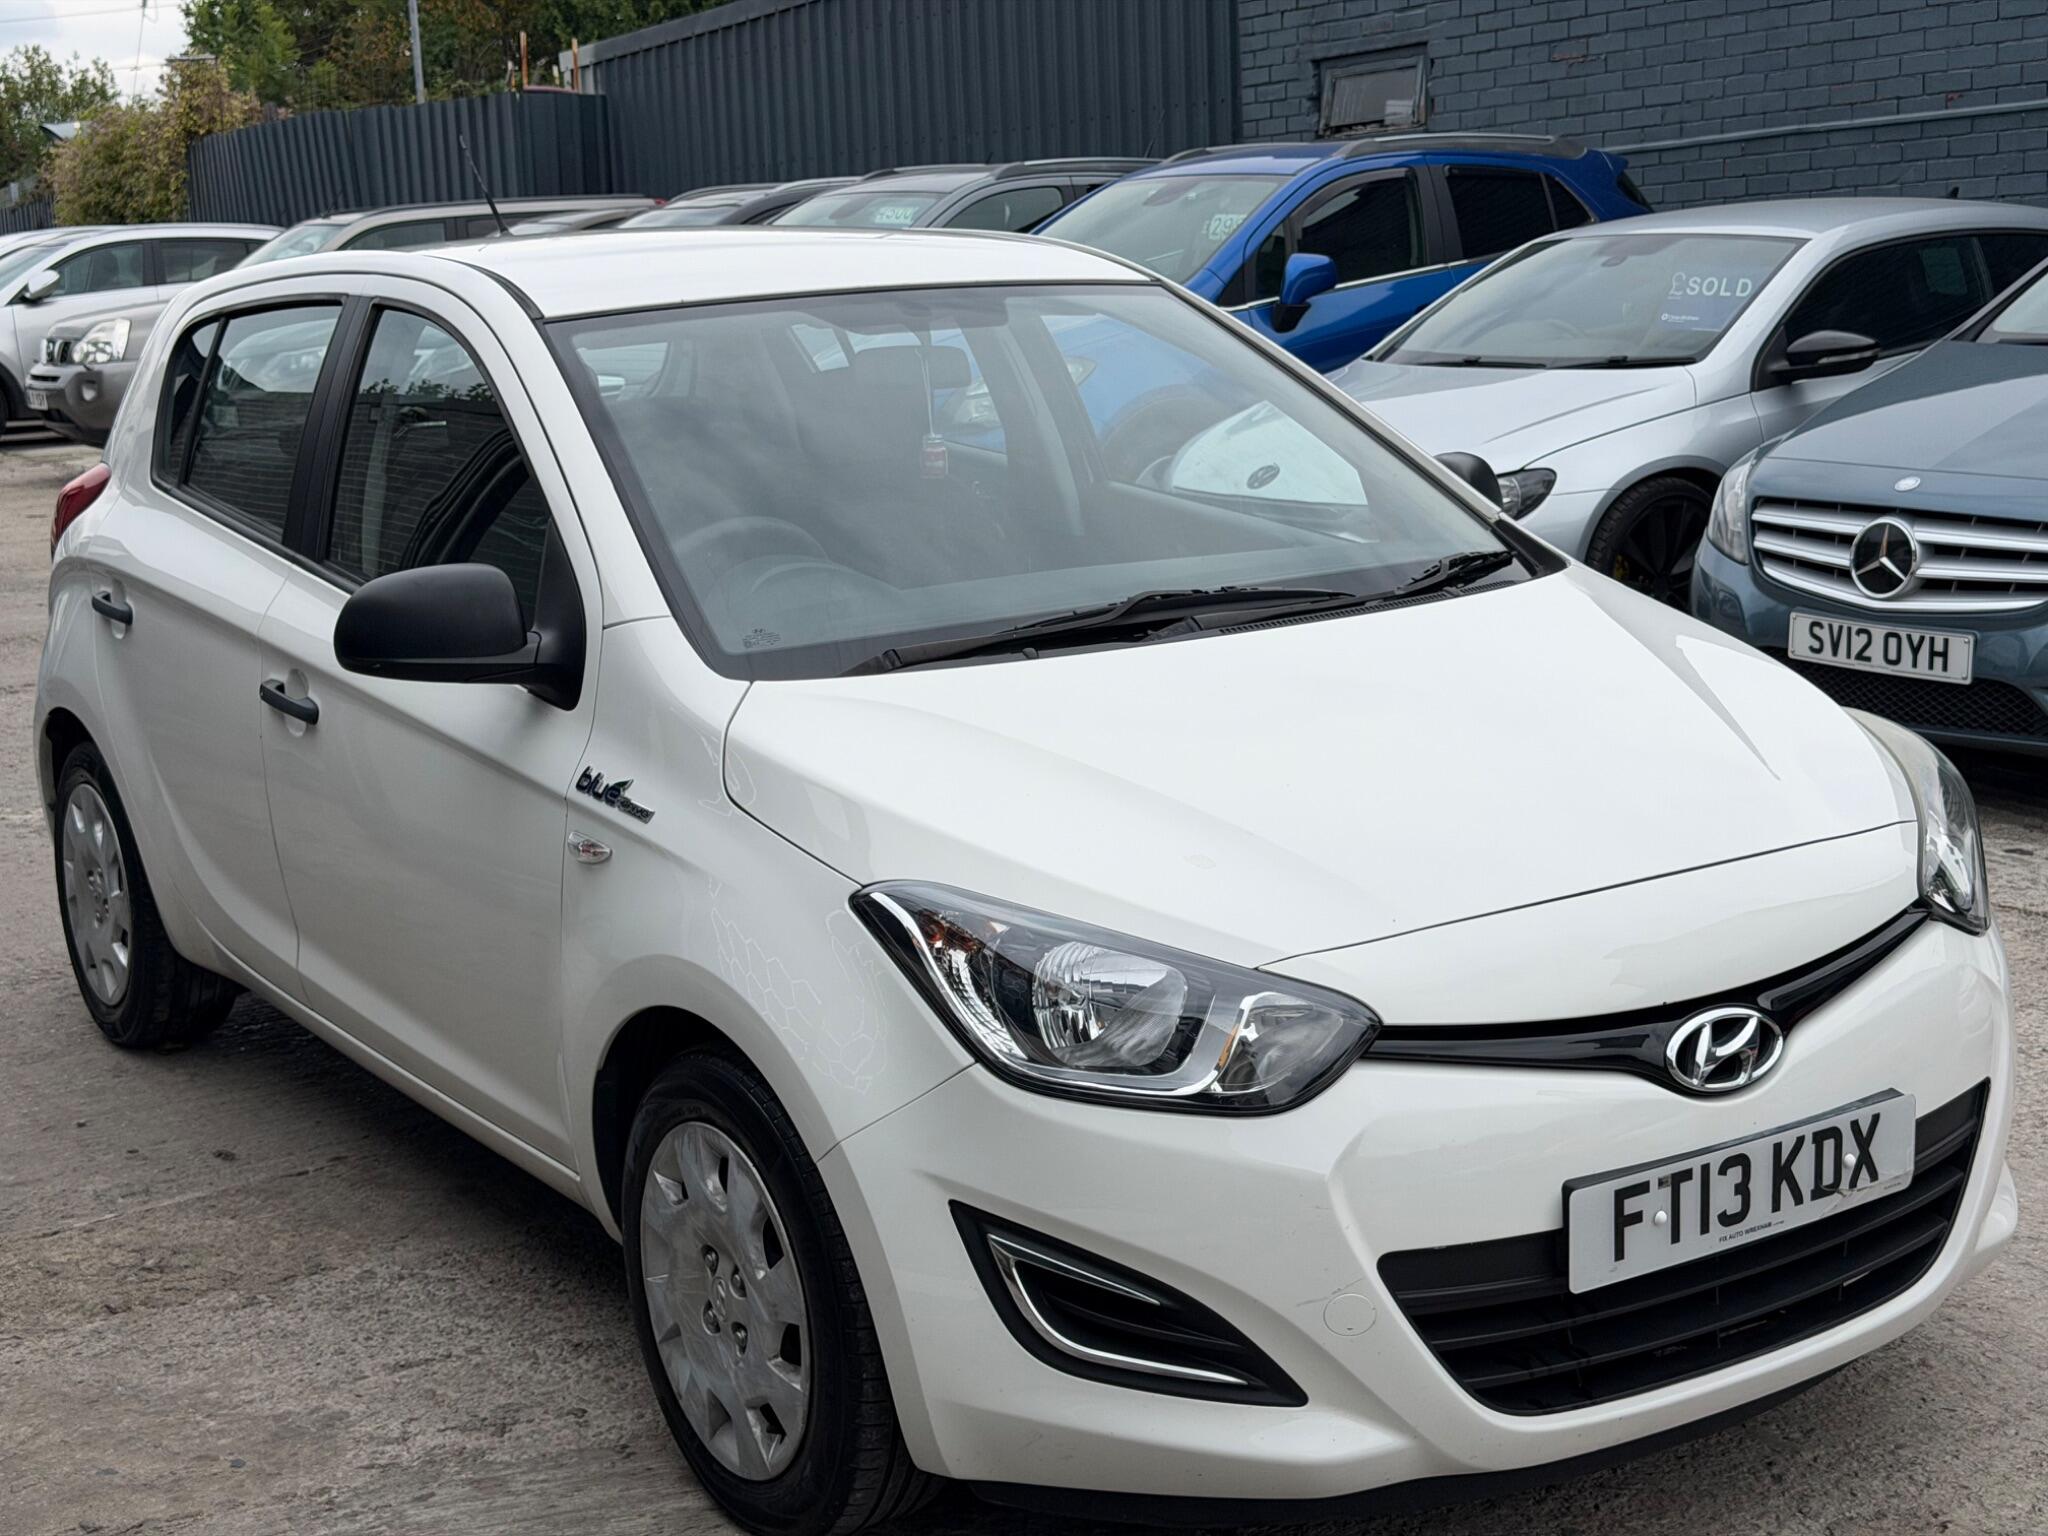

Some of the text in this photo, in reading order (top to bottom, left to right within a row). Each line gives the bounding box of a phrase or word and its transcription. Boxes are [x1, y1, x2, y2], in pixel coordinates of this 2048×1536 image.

[1808, 621, 1949, 672] SV12 OYH
[576, 766, 622, 807] blue
[1614, 1112, 1880, 1262] FT13 KDX
[1729, 1230, 1744, 1240] AUTO
